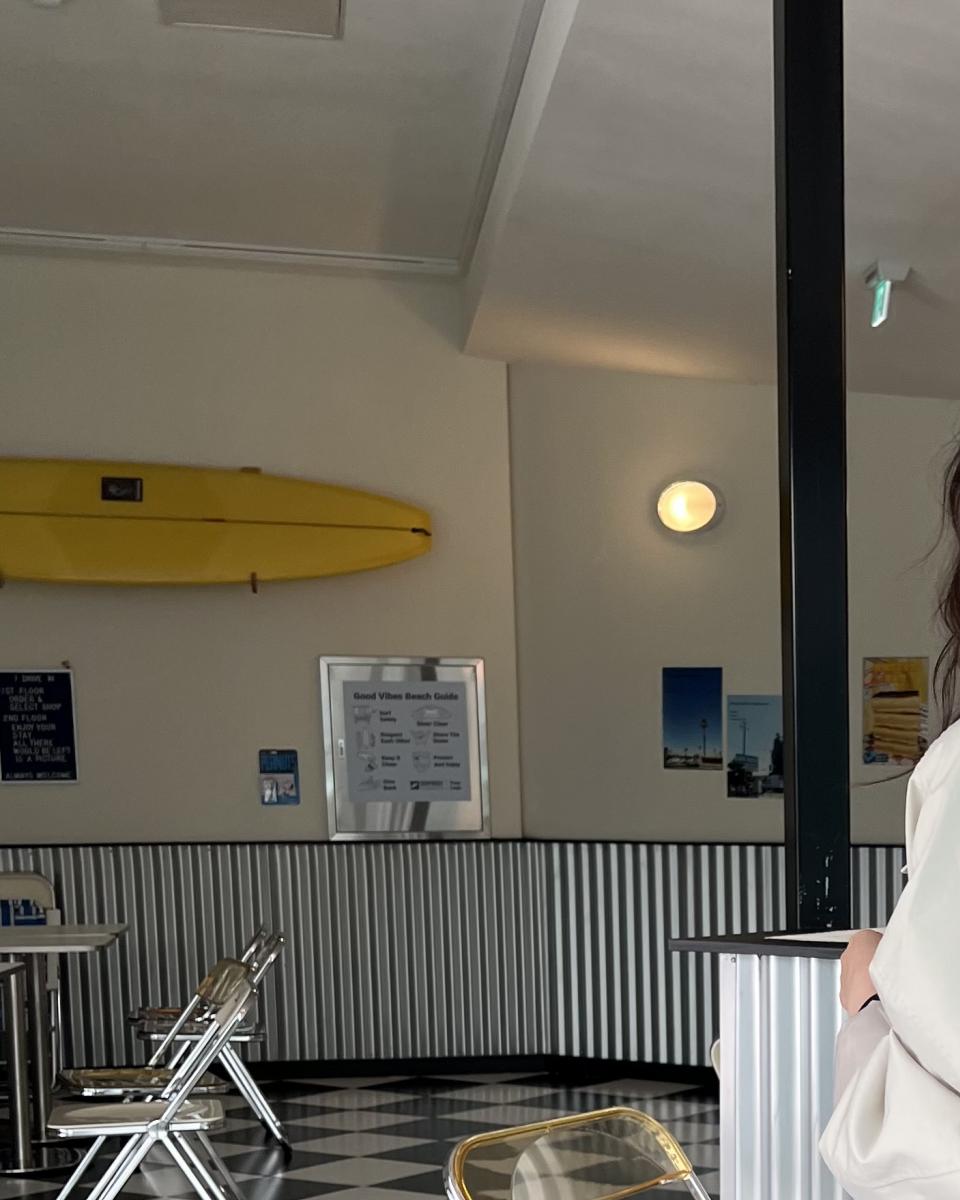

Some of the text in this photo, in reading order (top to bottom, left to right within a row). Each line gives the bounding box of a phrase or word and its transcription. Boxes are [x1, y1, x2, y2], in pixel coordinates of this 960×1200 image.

[18, 687, 44, 695] FLOOR
[353, 692, 459, 700] Good Vibes Beach Guide
[22, 714, 47, 722] FLOOR
